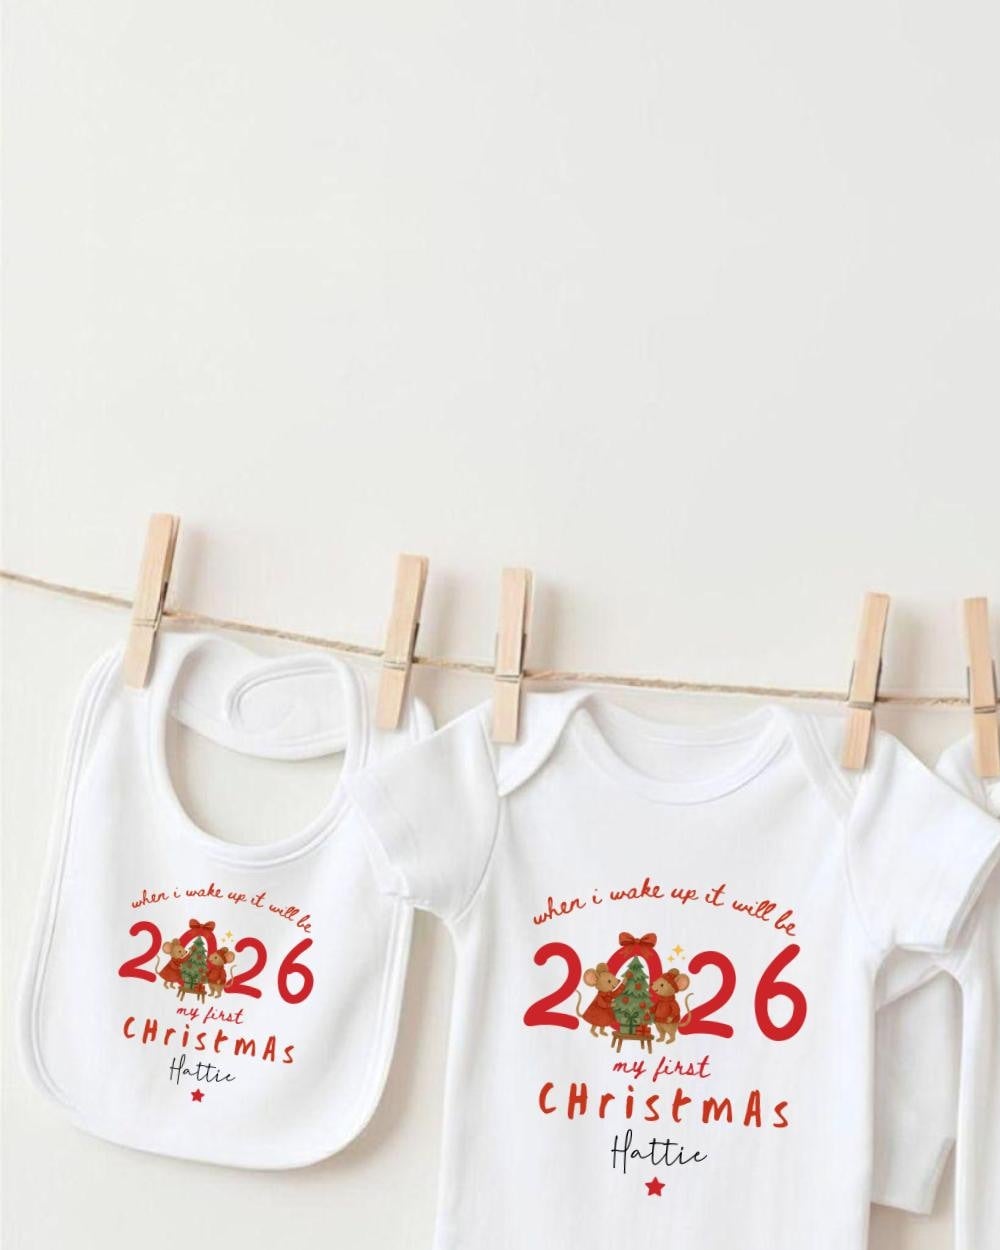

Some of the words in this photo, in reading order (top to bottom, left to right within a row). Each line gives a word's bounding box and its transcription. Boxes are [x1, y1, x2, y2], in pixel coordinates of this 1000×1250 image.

[132, 889, 169, 908] when
[174, 887, 181, 899] i
[186, 883, 223, 898] wake
[228, 892, 246, 904] up
[251, 892, 266, 907] it
[269, 905, 300, 921] will
[297, 915, 312, 933] be
[533, 896, 586, 925] when
[592, 888, 603, 905] i
[610, 877, 664, 900] wake
[671, 889, 698, 904] up
[705, 884, 726, 906] it
[732, 900, 776, 921] will
[775, 910, 797, 936] be
[176, 1008, 199, 1020] my
[203, 1007, 244, 1024] first
[169, 1054, 236, 1085] Hattie
[613, 1061, 646, 1079] my
[653, 1055, 711, 1082] first
[610, 1129, 707, 1174] Hattie
